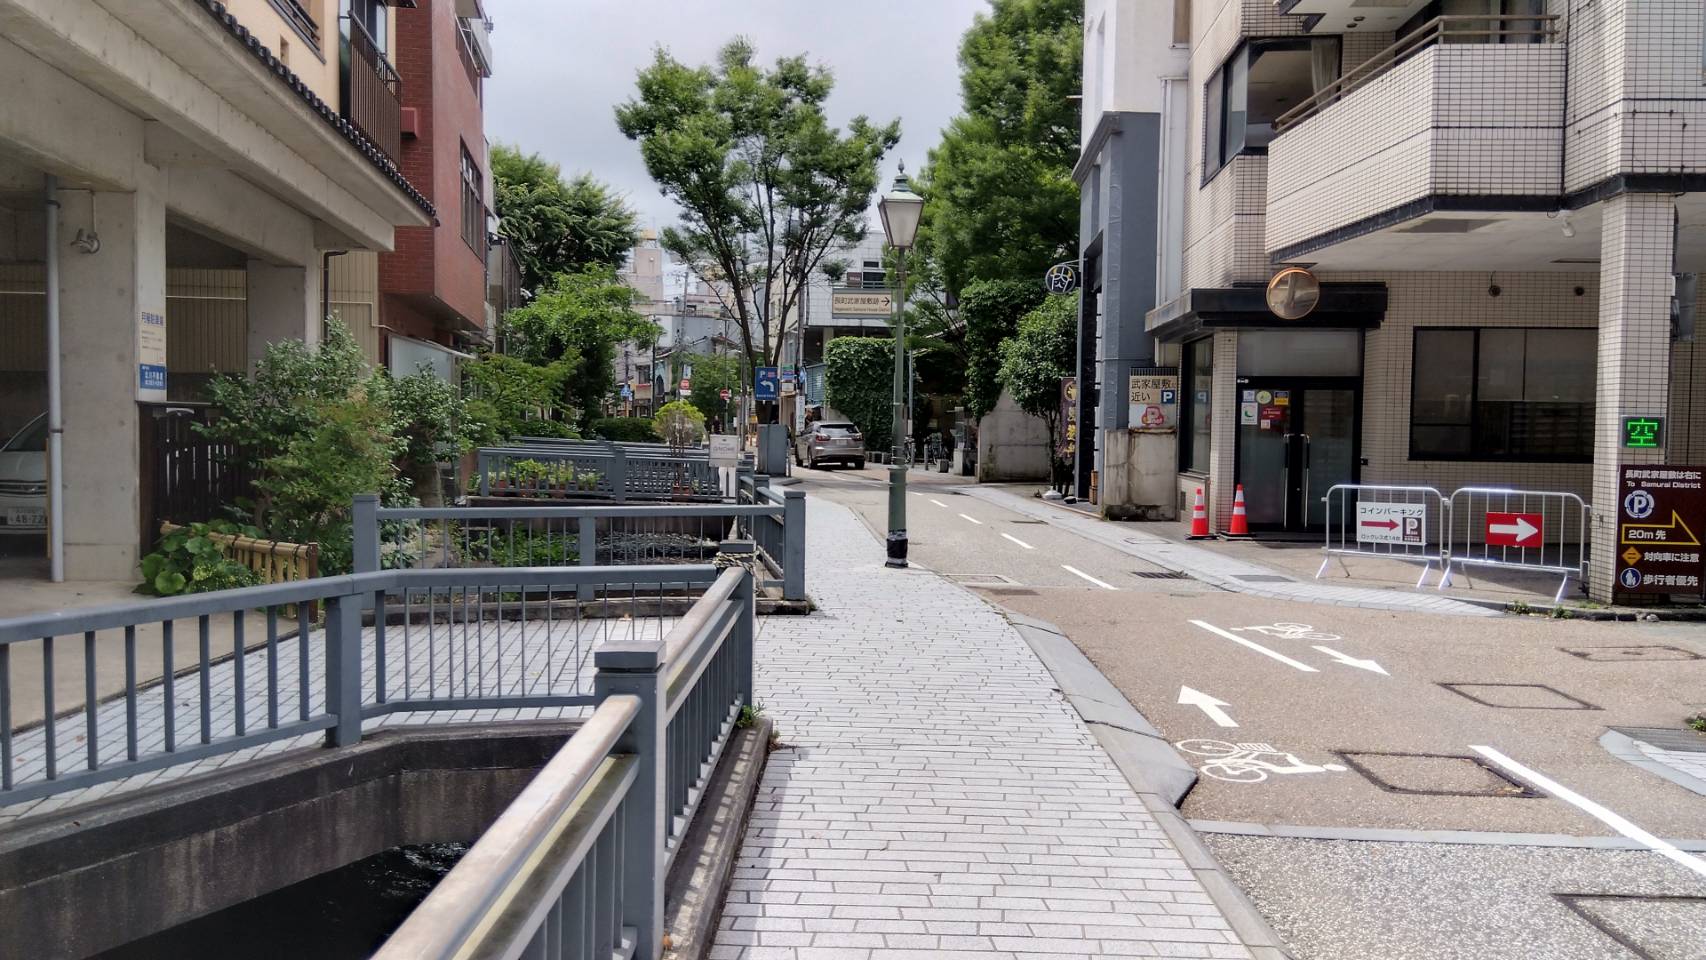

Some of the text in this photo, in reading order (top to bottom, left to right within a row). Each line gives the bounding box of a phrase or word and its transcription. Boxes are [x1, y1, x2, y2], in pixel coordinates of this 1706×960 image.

[1131, 392, 1151, 402] 近い
[1163, 391, 1173, 402] P
[1627, 418, 1658, 446] 空
[1625, 469, 1701, 480] 長町武家屋敷は右に
[1672, 481, 1701, 489] District
[1644, 552, 1700, 562] 対向車に注意
[1643, 575, 1698, 586] 歩行者優先
